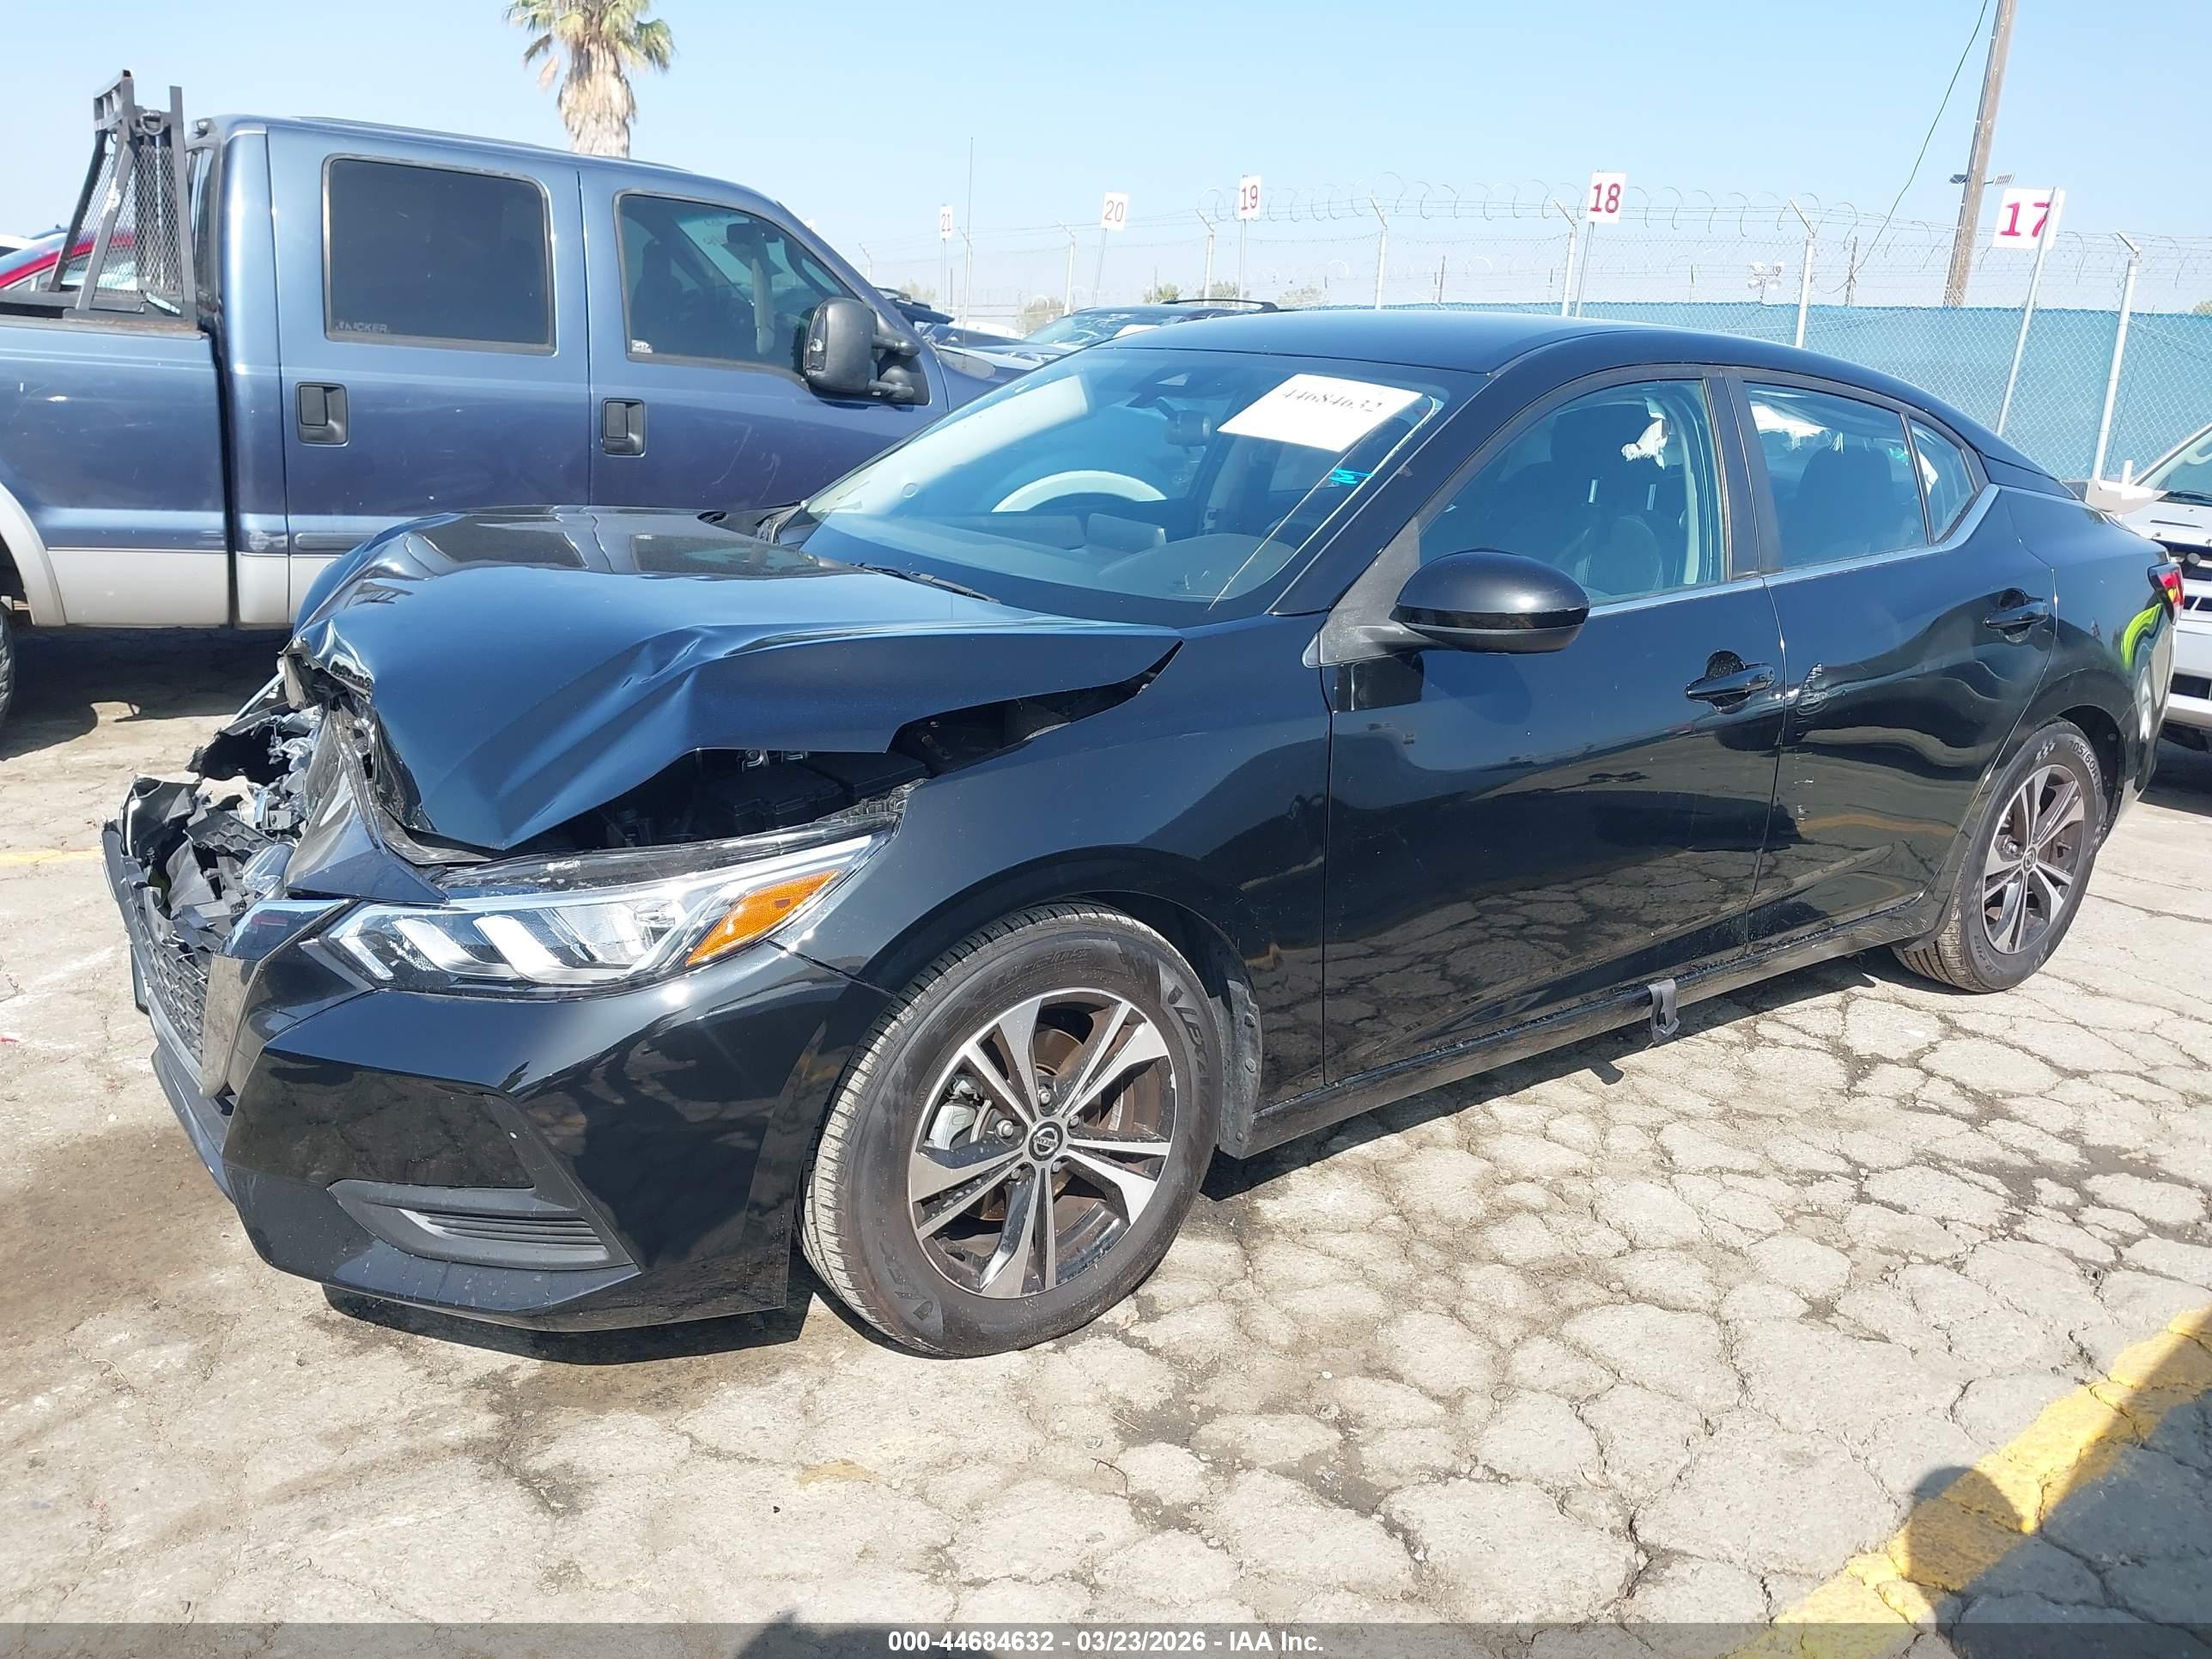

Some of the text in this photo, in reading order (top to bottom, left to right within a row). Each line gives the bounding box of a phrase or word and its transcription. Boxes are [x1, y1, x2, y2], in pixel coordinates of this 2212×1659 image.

[1241, 185, 1258, 210] 19
[1589, 182, 1621, 213] 18
[940, 213, 951, 232] 21
[1104, 200, 1124, 222] 20
[1999, 201, 2051, 238] 17
